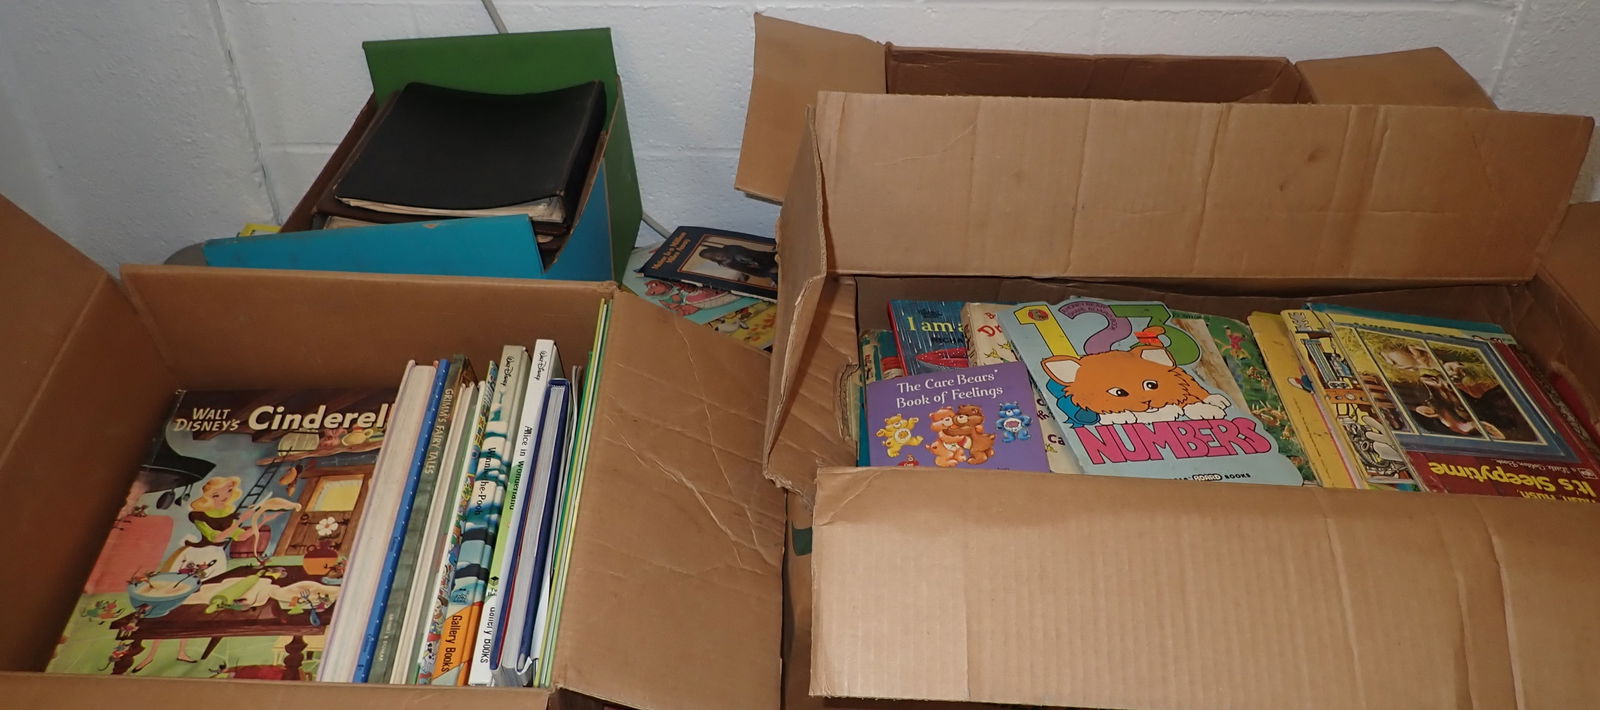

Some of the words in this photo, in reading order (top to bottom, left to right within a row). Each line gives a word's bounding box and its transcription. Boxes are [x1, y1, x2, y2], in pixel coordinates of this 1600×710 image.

[907, 316, 916, 331] I
[921, 321, 954, 332] am
[897, 382, 921, 394] The
[925, 378, 954, 389] Care
[438, 388, 454, 423] GRIMM'S
[896, 394, 930, 409] Book
[933, 391, 948, 404] of
[952, 387, 1003, 400] Feelings
[173, 418, 240, 432] DISNEY'S
[192, 407, 231, 421] WALT
[431, 425, 445, 449] FAIRY
[522, 425, 533, 446] Alice
[1074, 417, 1272, 465] NUMBERS
[424, 451, 439, 474] TALES
[519, 449, 528, 457] in
[1428, 462, 1556, 492] Sleepytime
[1557, 478, 1598, 498] It's
[445, 615, 463, 644] Gallery
[441, 647, 456, 672] Books
